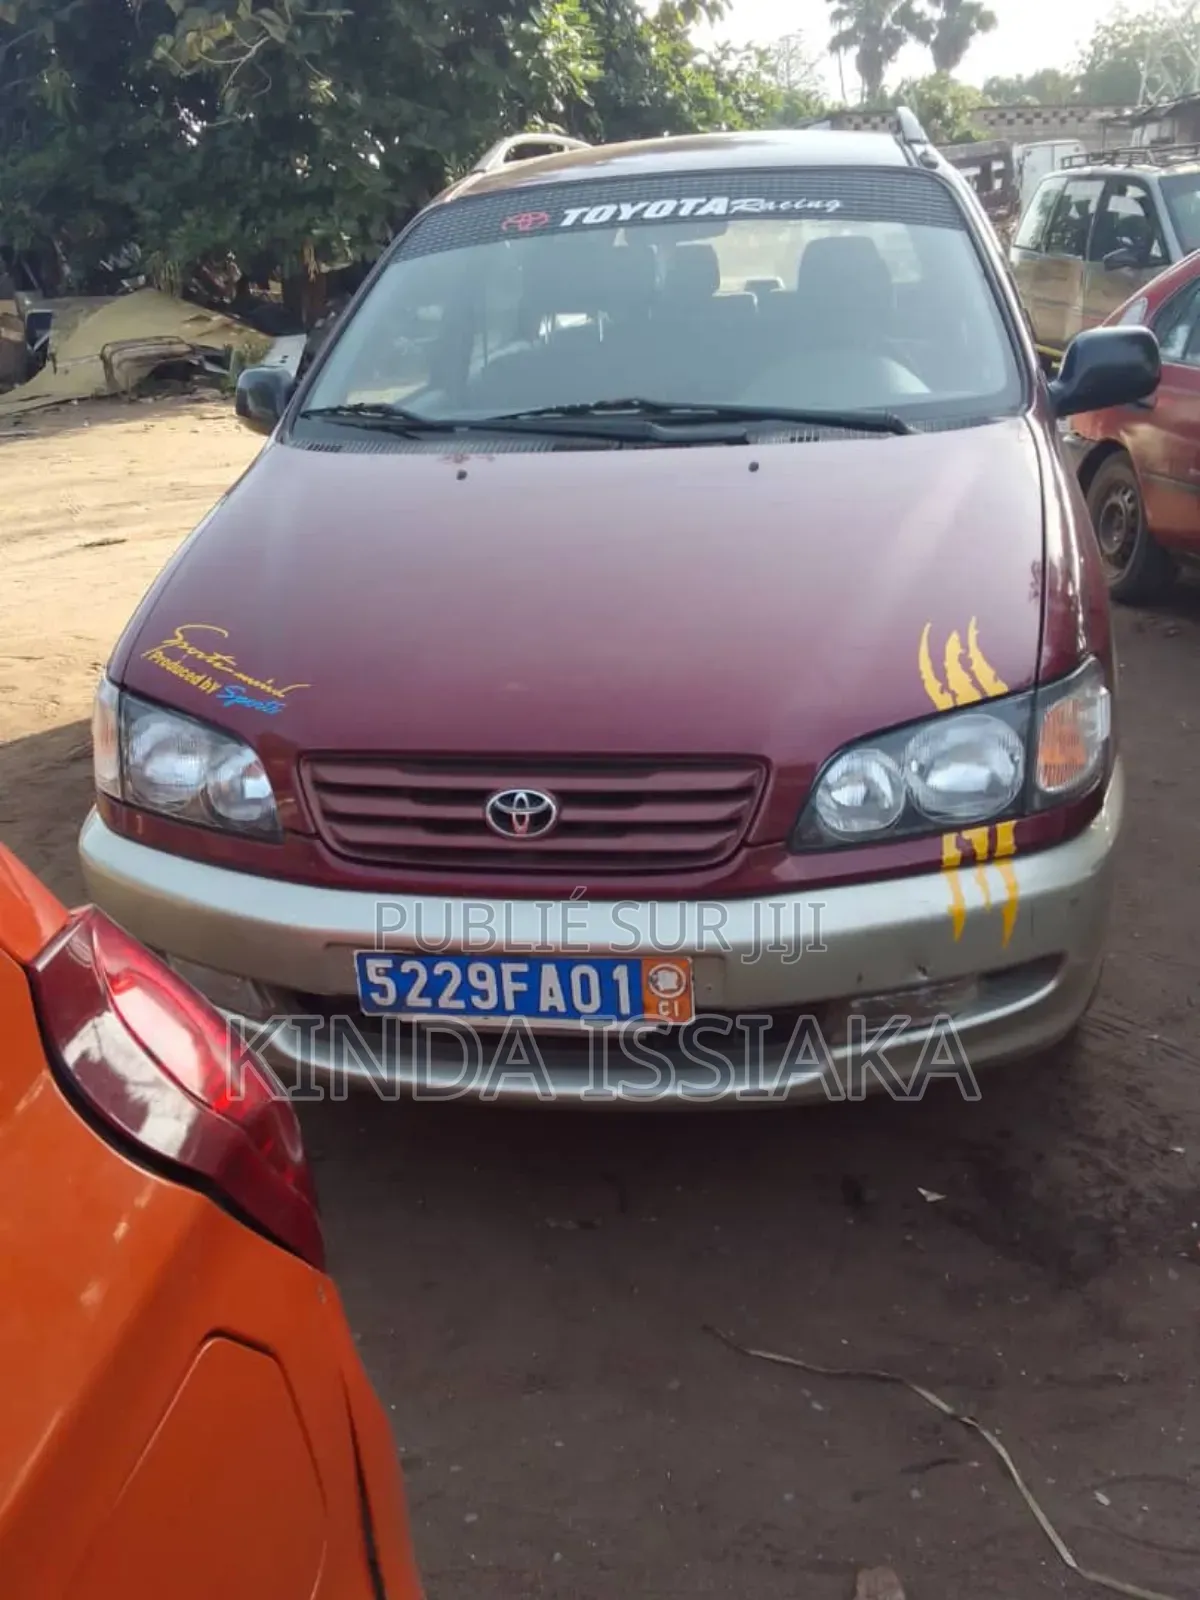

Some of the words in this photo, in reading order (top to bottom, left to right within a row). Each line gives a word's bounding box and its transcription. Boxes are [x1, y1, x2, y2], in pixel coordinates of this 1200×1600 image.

[560, 197, 729, 226] TOYOTA
[730, 198, 842, 214] Racing
[216, 684, 286, 715] Sports
[657, 1001, 680, 1018] CI
